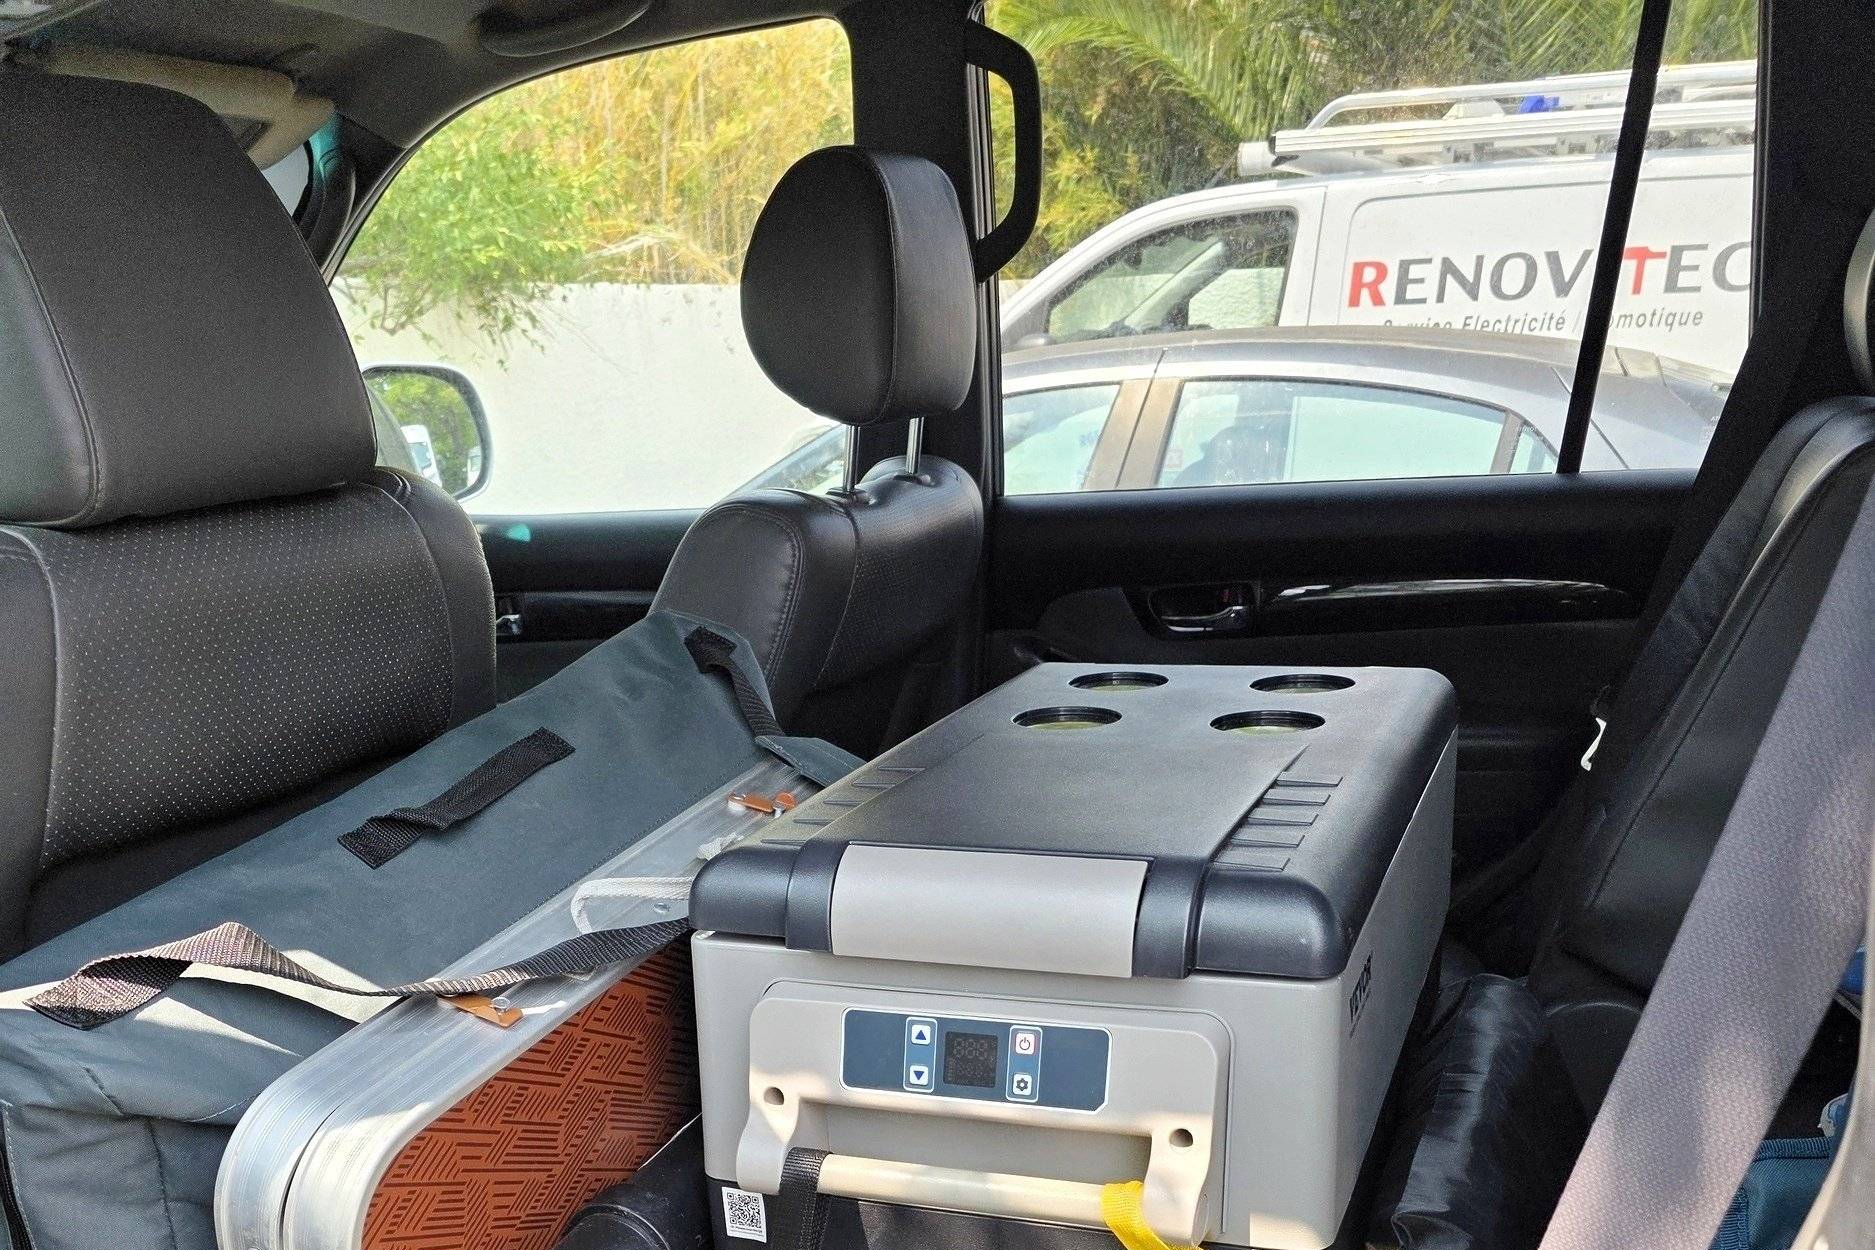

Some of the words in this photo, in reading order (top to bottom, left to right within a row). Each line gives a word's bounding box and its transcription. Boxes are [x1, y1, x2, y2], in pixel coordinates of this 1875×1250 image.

[1348, 242, 1750, 307] RENOVTEC
[1462, 309, 1566, 334] Electricité
[1609, 307, 1704, 332] motique
